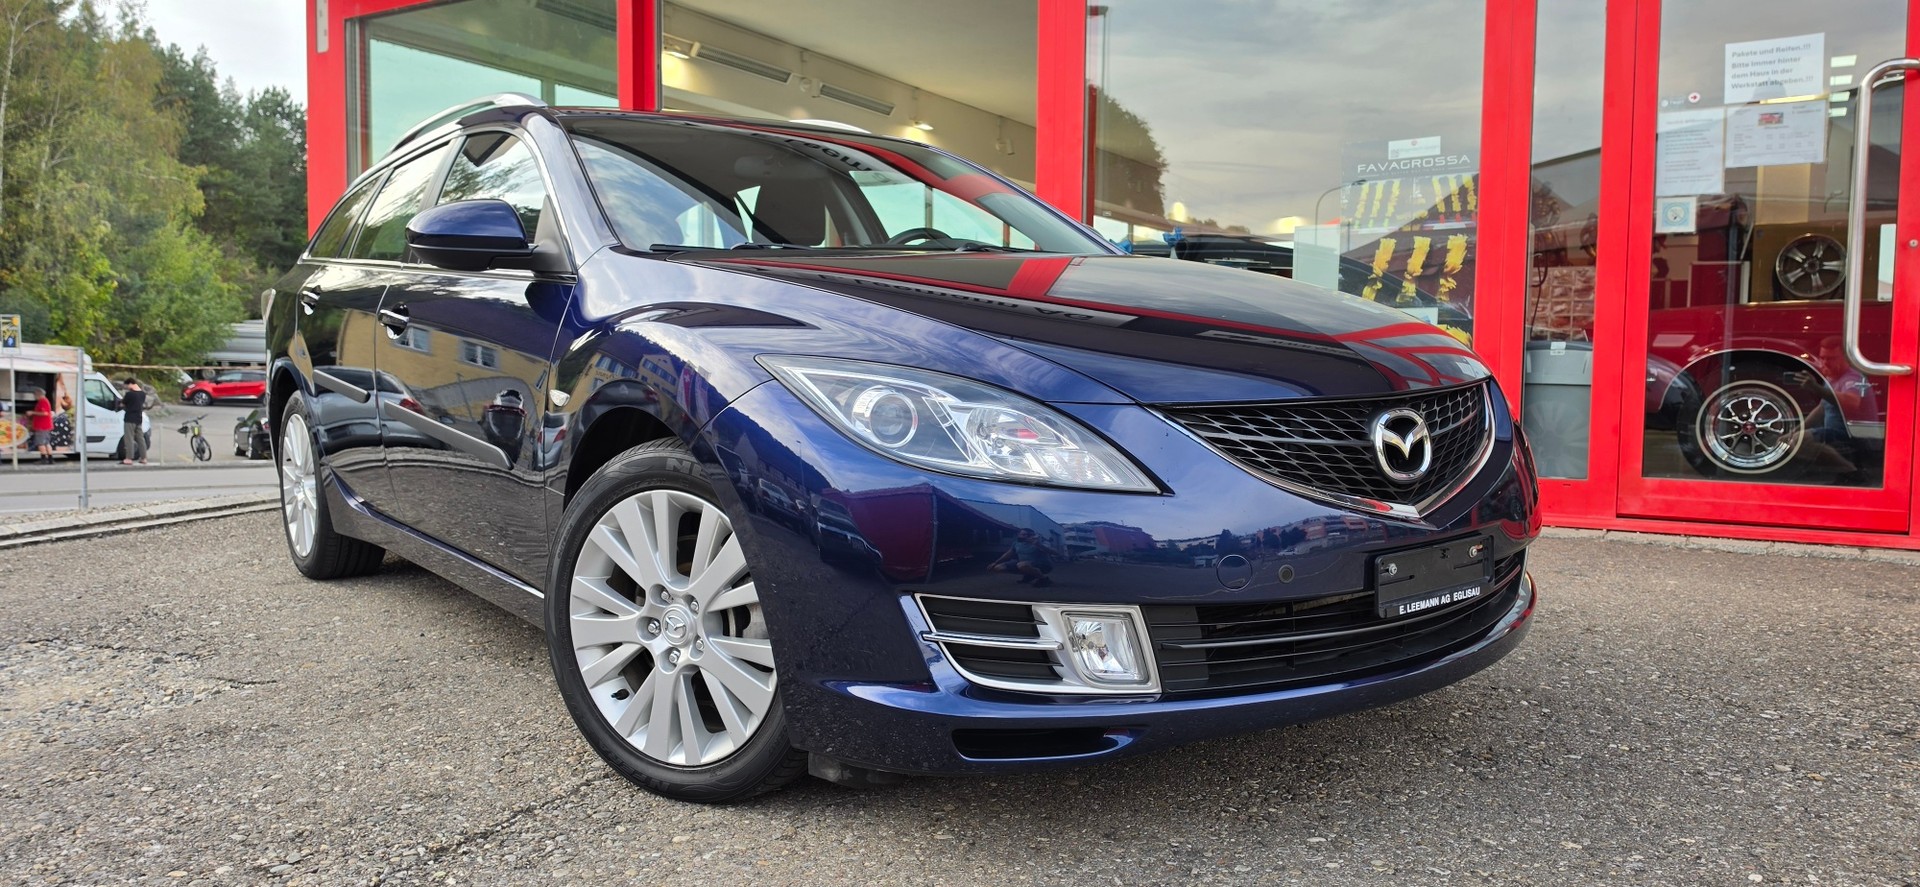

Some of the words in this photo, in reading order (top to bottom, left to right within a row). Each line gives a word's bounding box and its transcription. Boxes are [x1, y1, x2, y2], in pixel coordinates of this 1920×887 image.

[1732, 50, 1758, 58] Pakete
[1731, 80, 1768, 89] Werkstatt
[1357, 154, 1471, 174] FAVAGROSSA
[1399, 604, 1407, 615] E.
[1407, 597, 1440, 613] LEEMANN
[1441, 594, 1451, 604] AG
[1453, 587, 1481, 602] EGLISAU
